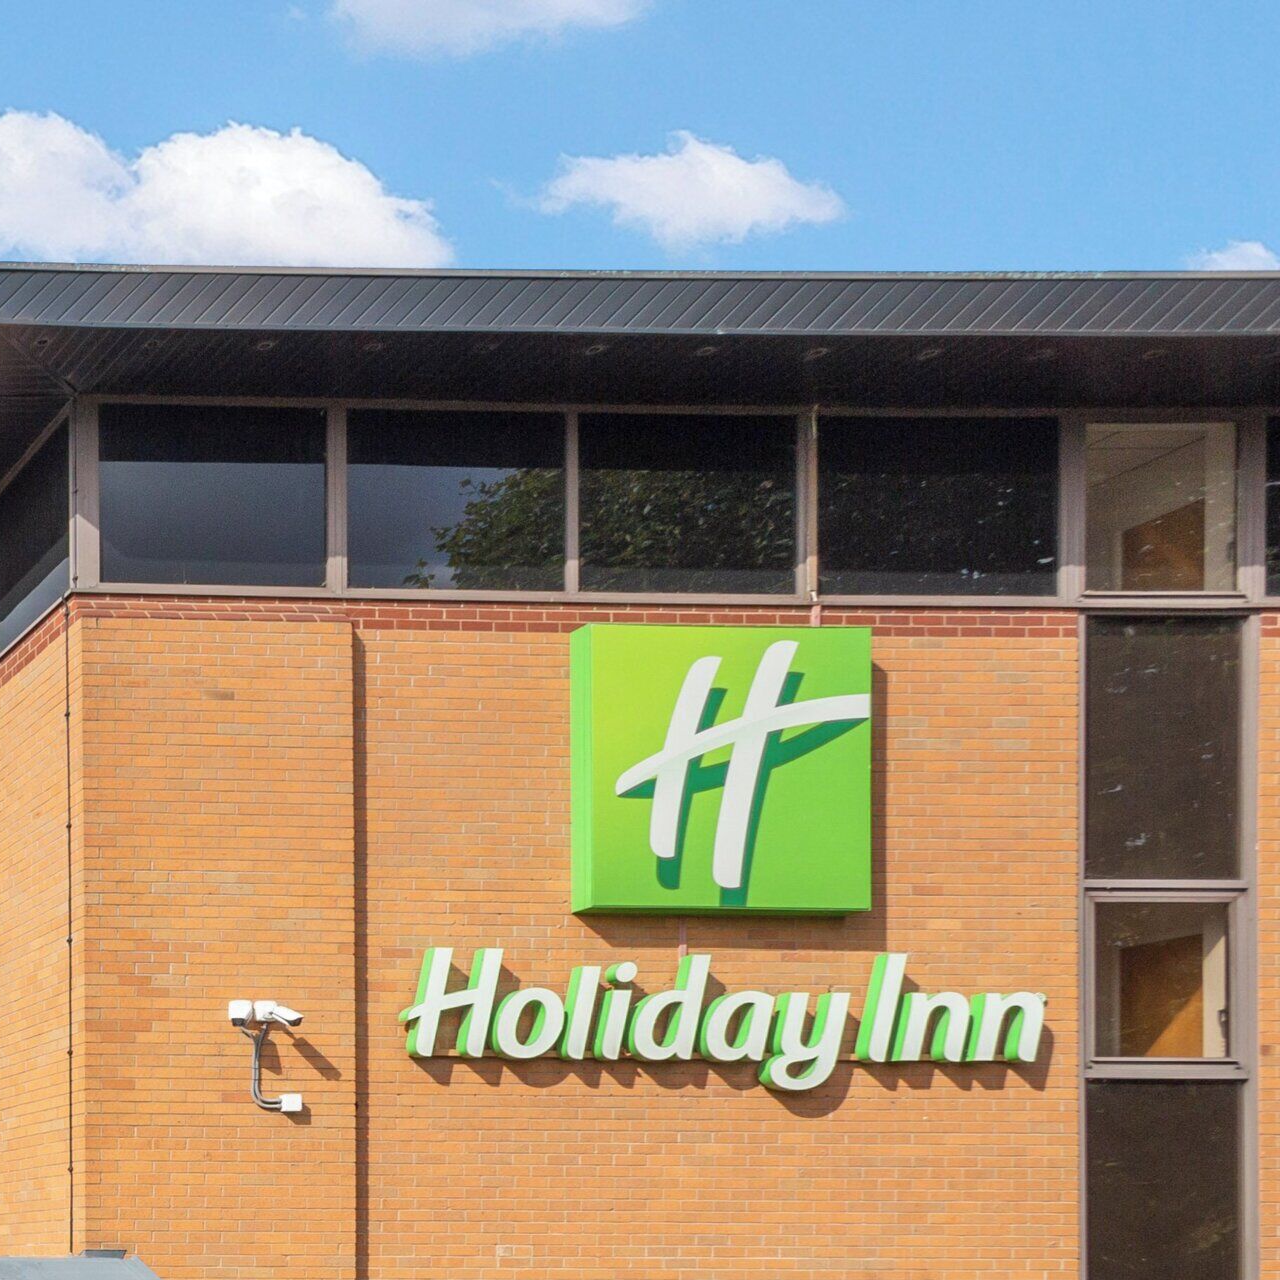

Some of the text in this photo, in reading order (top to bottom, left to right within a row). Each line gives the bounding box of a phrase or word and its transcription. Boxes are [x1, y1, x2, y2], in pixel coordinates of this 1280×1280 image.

[615, 640, 870, 889] H
[399, 947, 1047, 1091] Holiday Inn
